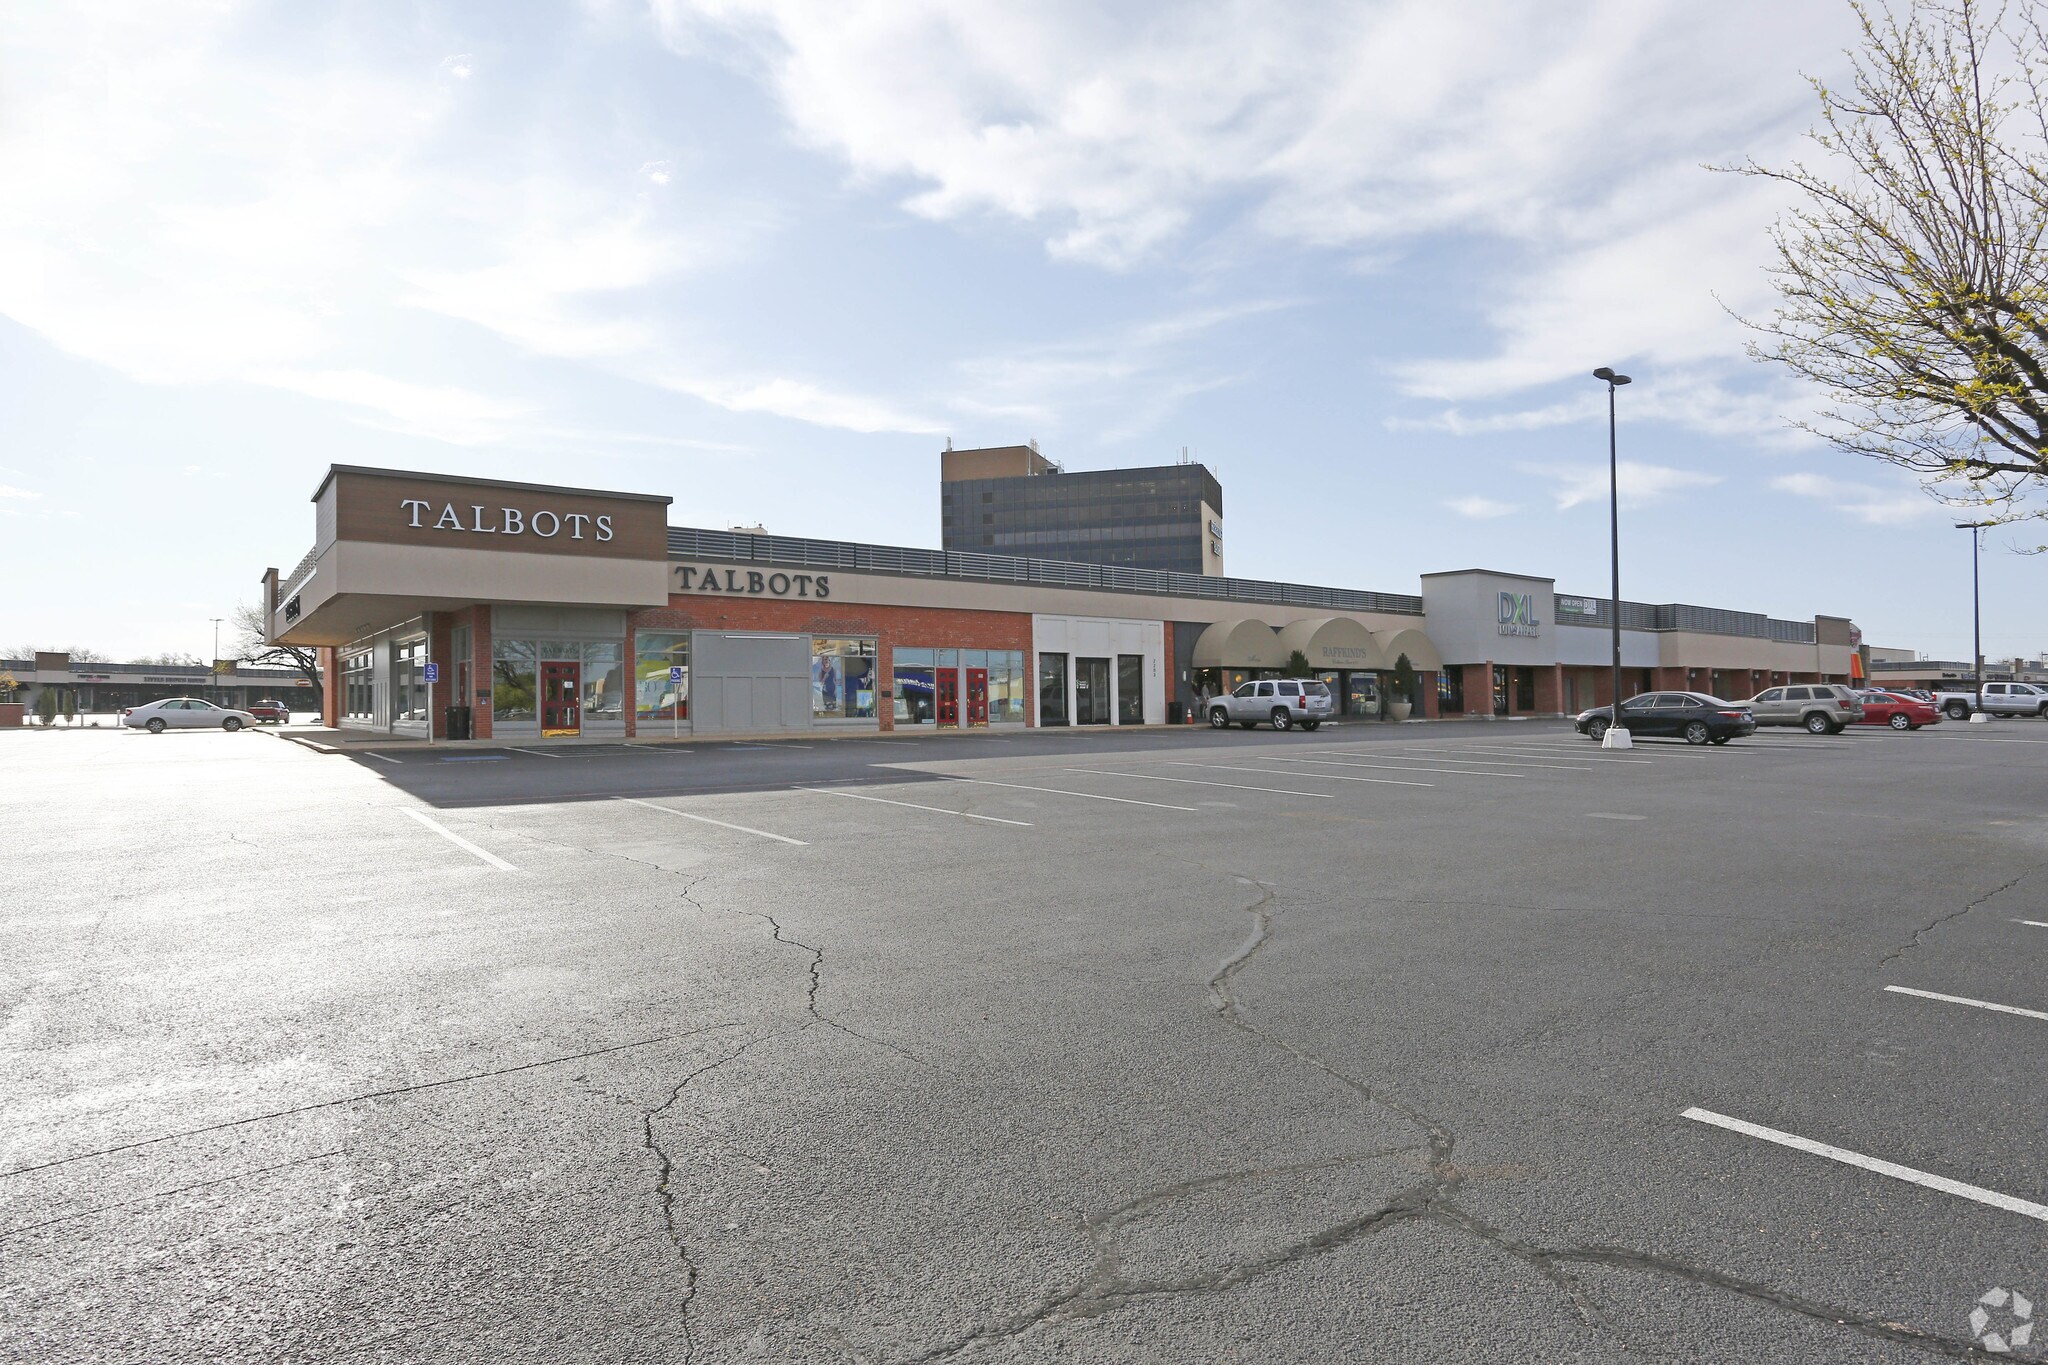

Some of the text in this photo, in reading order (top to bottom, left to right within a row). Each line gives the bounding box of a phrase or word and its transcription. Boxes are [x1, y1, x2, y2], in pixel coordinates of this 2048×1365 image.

[400, 499, 614, 541] TALBOTS
[674, 566, 830, 598] TALBOTS
[1498, 591, 1540, 625] DXL
[1322, 646, 1367, 658] RAFFKIND'S
